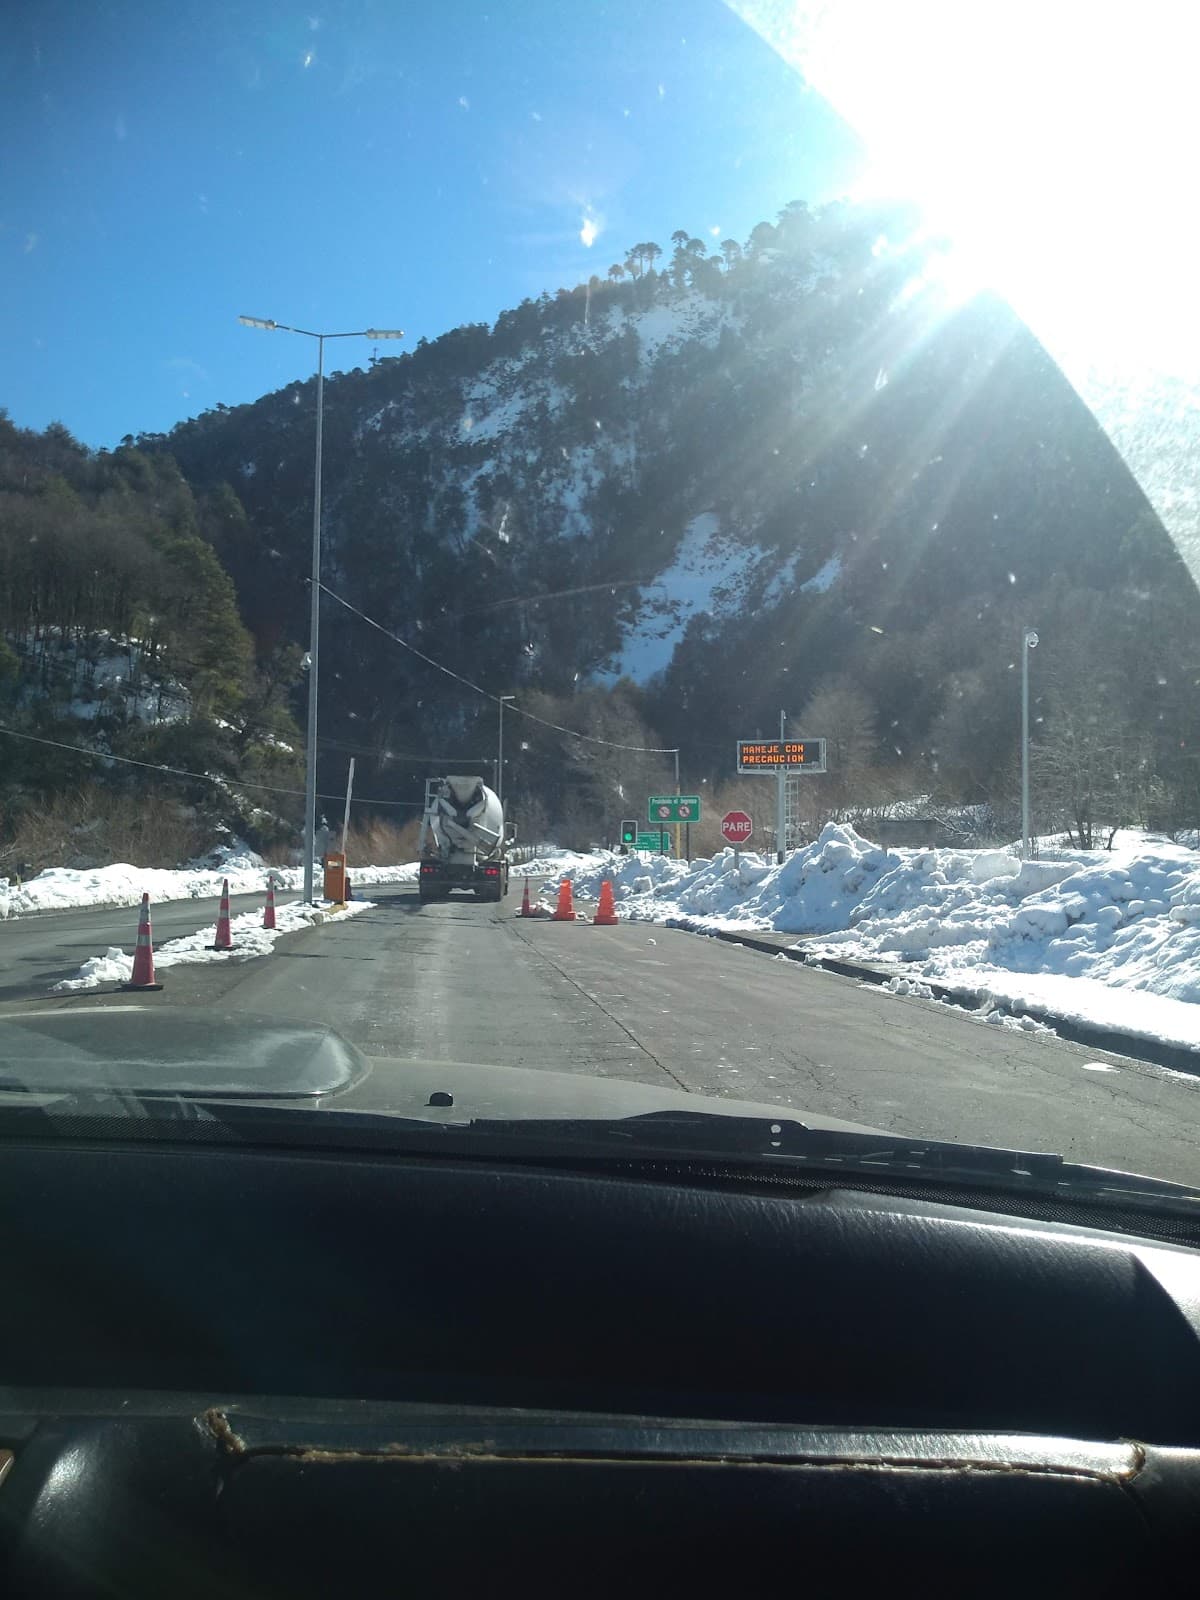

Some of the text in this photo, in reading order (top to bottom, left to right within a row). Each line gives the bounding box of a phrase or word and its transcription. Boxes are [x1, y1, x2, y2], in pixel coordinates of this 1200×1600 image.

[743, 744, 804, 754] MANEJE CON
[743, 755, 804, 763] PRECAUCION
[722, 821, 750, 832] PARE
